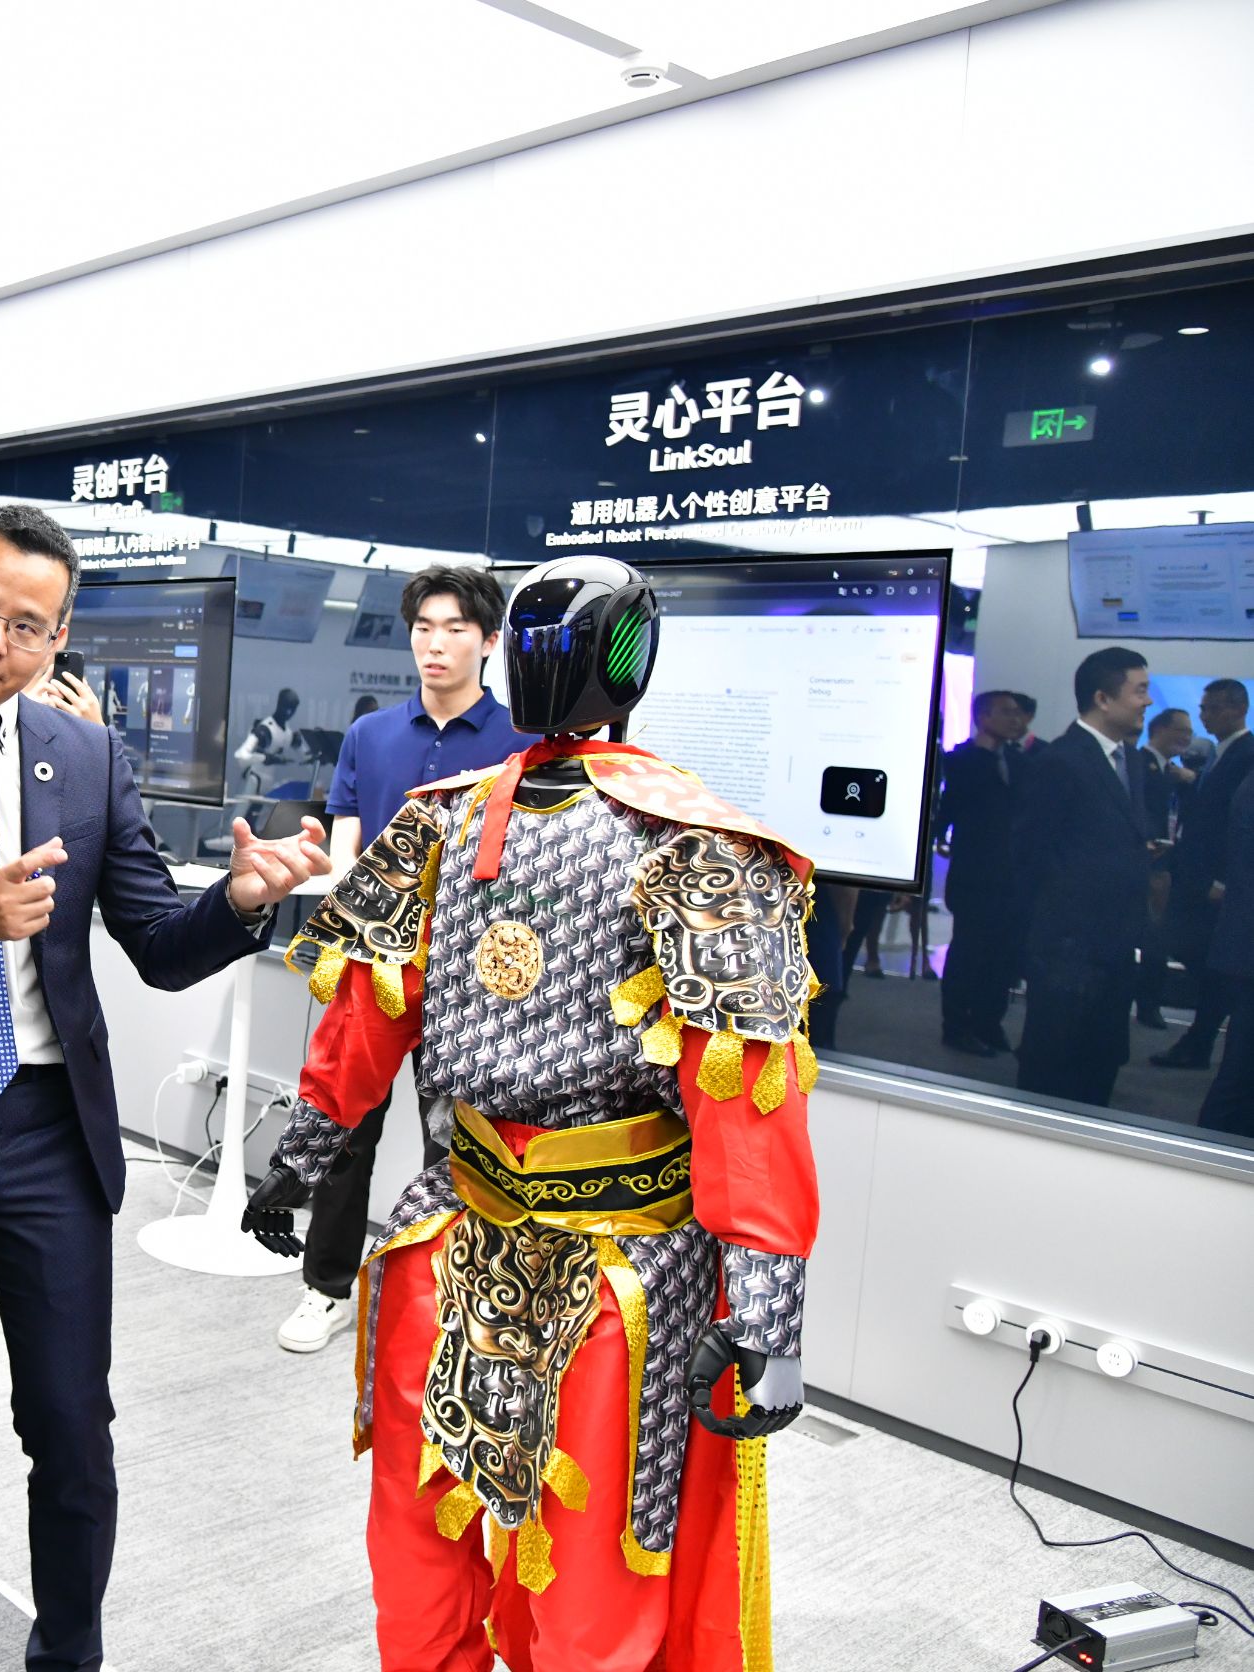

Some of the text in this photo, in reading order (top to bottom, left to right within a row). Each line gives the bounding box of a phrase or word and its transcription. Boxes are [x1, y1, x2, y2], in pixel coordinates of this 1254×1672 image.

[605, 371, 805, 446] 灵心平台
[649, 440, 752, 473] LinkSoul
[71, 453, 169, 502] 灵创平台
[570, 483, 831, 526] 通用机器人个性创意平台
[546, 530, 603, 546] Embodied
[605, 528, 642, 543] Robot
[808, 687, 832, 696] Debug
[809, 676, 855, 685] Conversation
